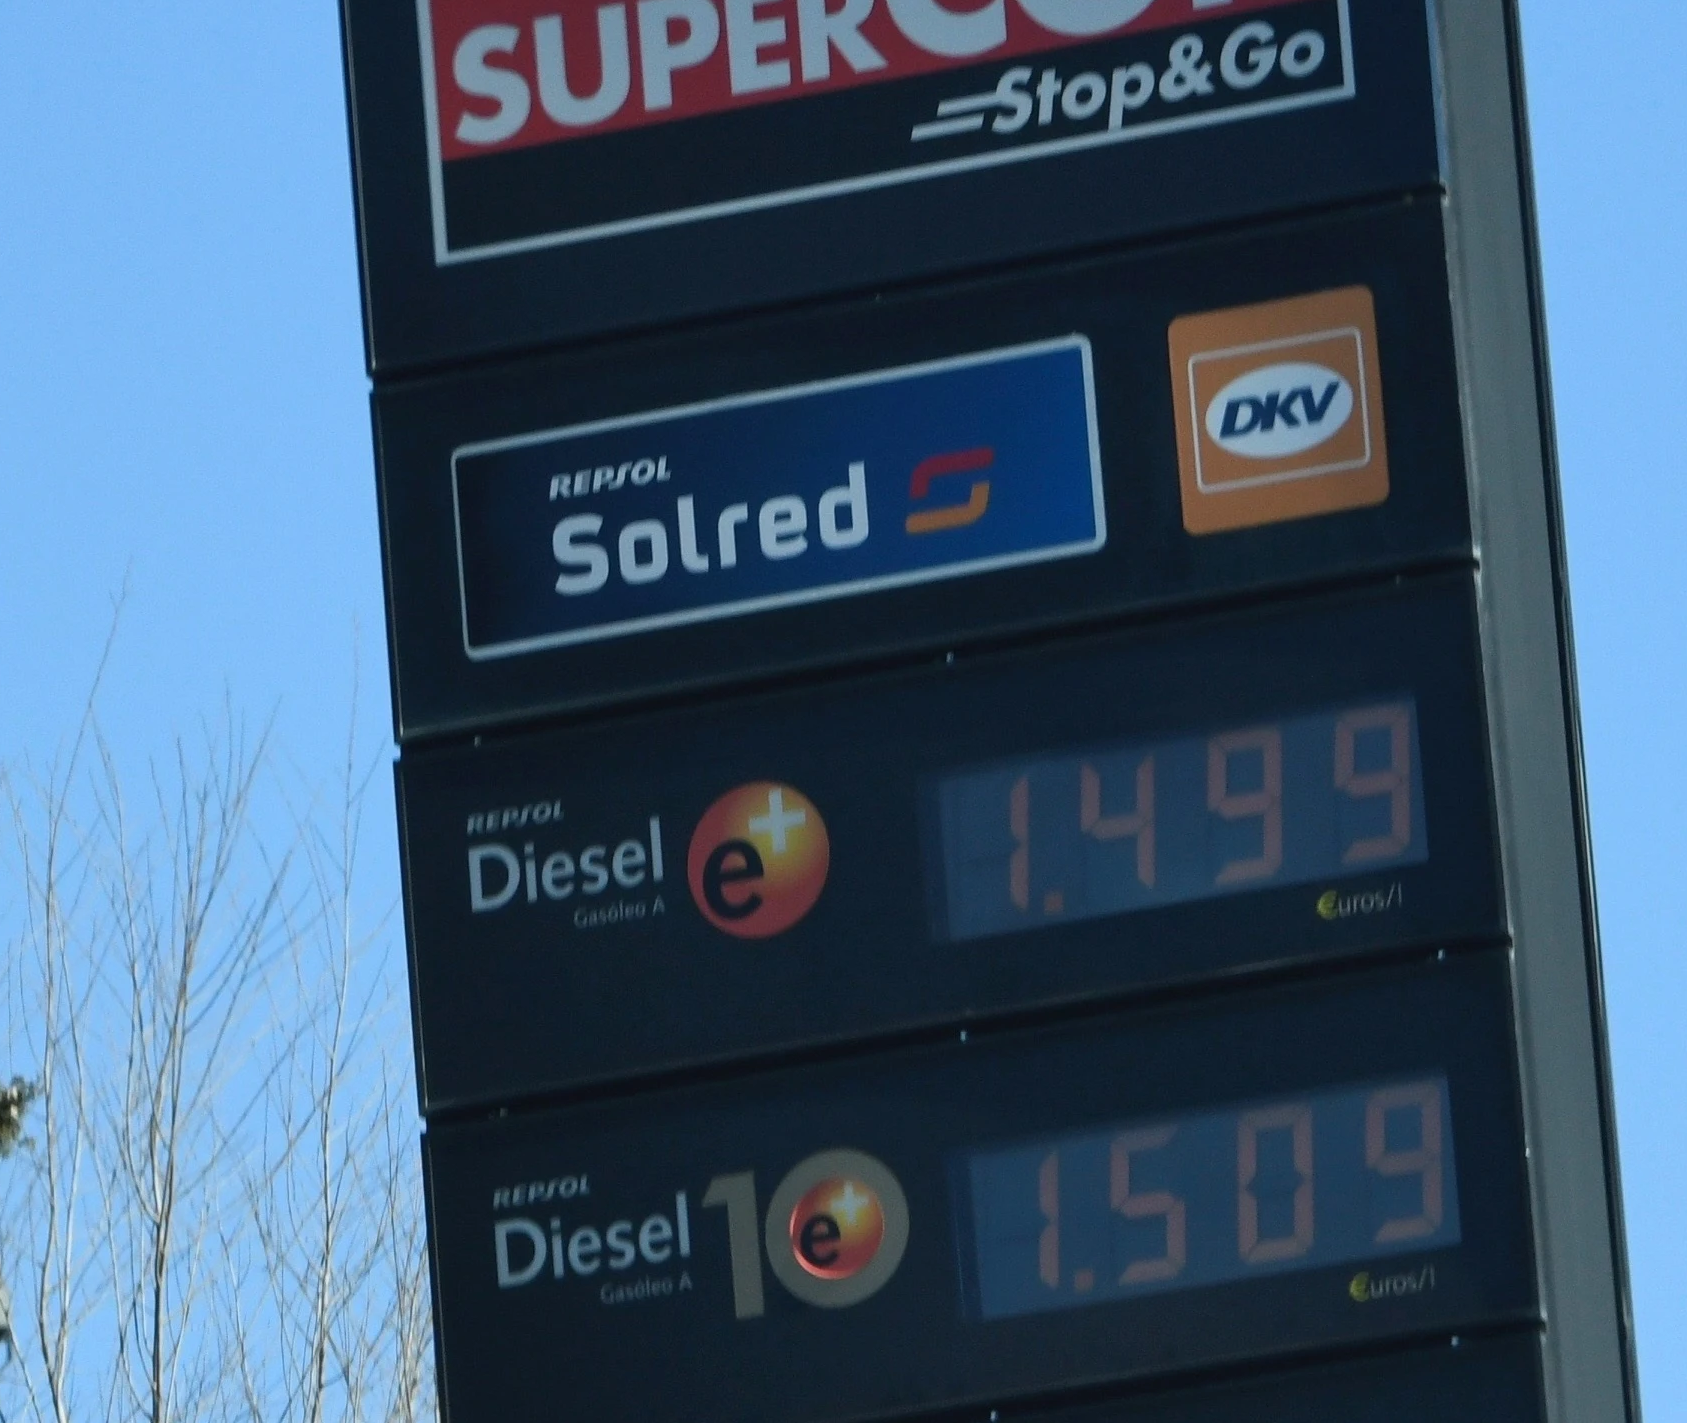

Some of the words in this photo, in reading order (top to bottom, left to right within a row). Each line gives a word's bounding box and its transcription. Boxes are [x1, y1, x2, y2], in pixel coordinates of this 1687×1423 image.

[992, 20, 1325, 133] Stop&Go
[1219, 381, 1342, 438] DKV
[549, 455, 671, 501] REPSOL
[552, 460, 869, 596] Solred
[467, 799, 564, 836] REPSOL
[1010, 702, 1410, 914] 1.499
[468, 816, 663, 913] Diesel
[493, 1174, 591, 1210] REPSOL
[1039, 1081, 1442, 1293] 1.509
[495, 1190, 690, 1289] Diesel
